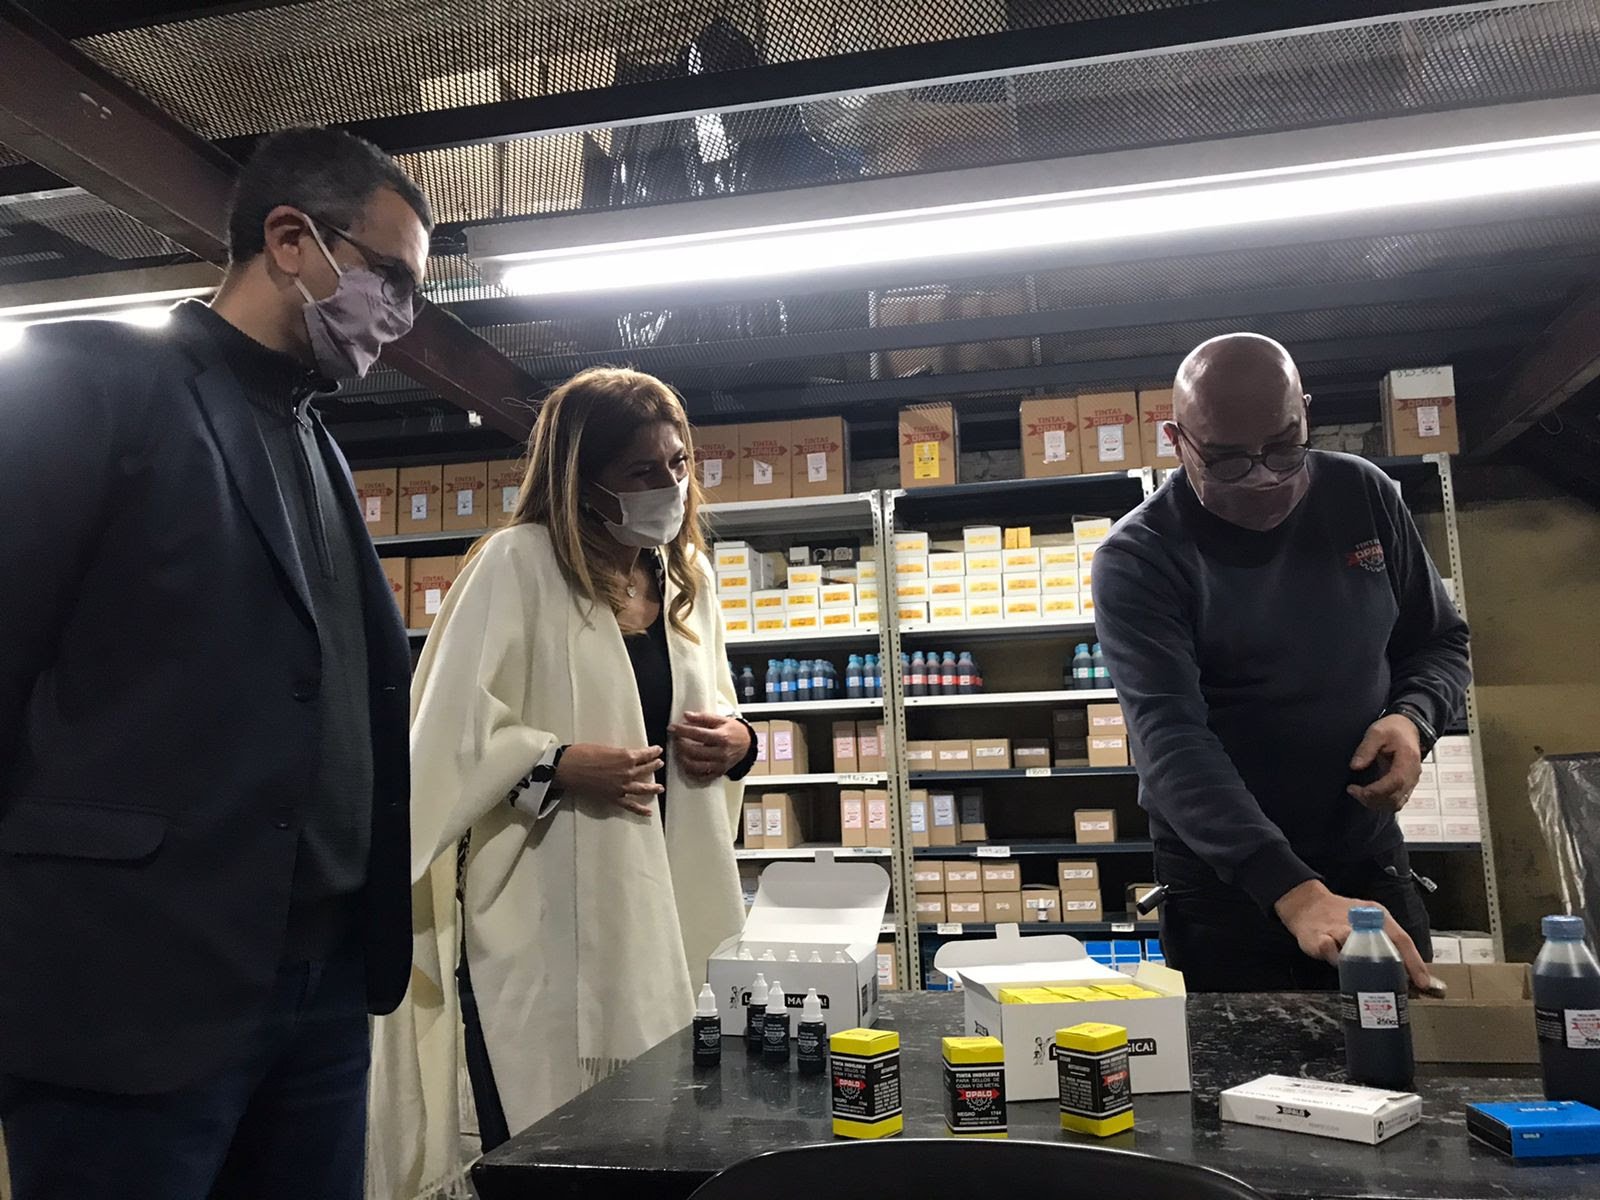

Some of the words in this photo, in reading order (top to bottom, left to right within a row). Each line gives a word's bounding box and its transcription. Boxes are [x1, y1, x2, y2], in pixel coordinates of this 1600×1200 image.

[1094, 409, 1122, 417] TINTAS
[1037, 416, 1065, 424] TINTAS
[1093, 415, 1125, 426] OPALO
[1036, 422, 1068, 433] OPALO
[911, 432, 942, 443] OPALO
[752, 440, 778, 448] TINTAS
[839, 1079, 860, 1088] OPALO
[965, 1089, 992, 1098] OPALO
